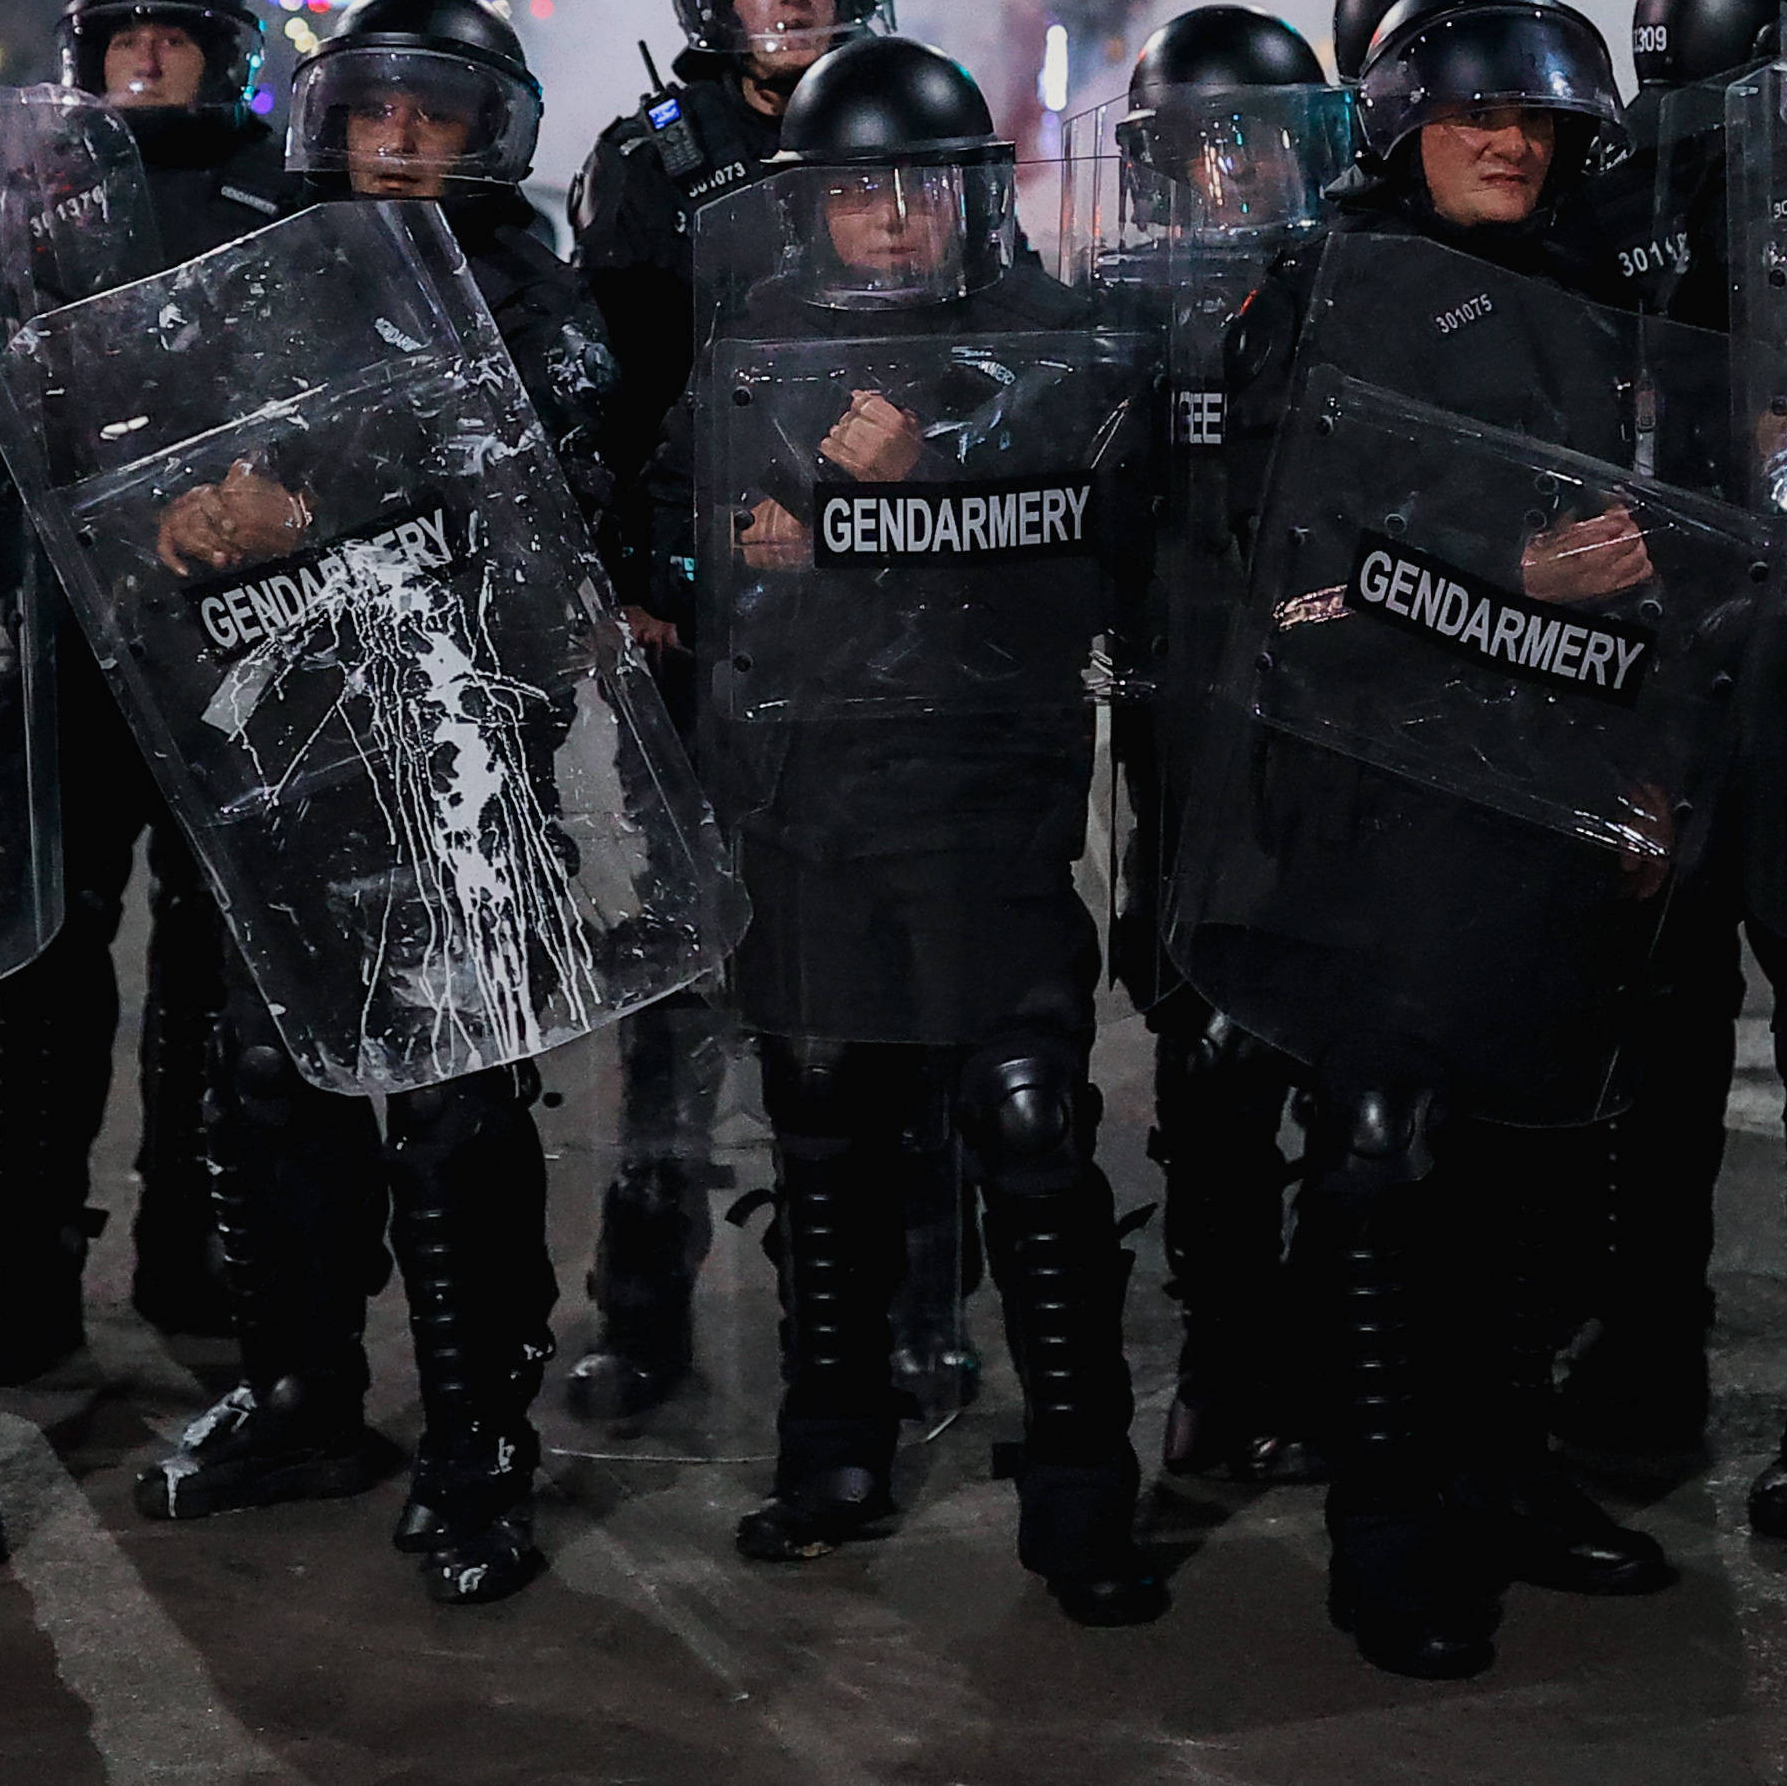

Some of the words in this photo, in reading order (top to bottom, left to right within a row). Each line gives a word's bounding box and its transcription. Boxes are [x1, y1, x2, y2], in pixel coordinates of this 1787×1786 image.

[1434, 293, 1493, 334] 301075
[823, 485, 1091, 553] GENDARMERY
[1359, 550, 1645, 689] GENDARMERY
